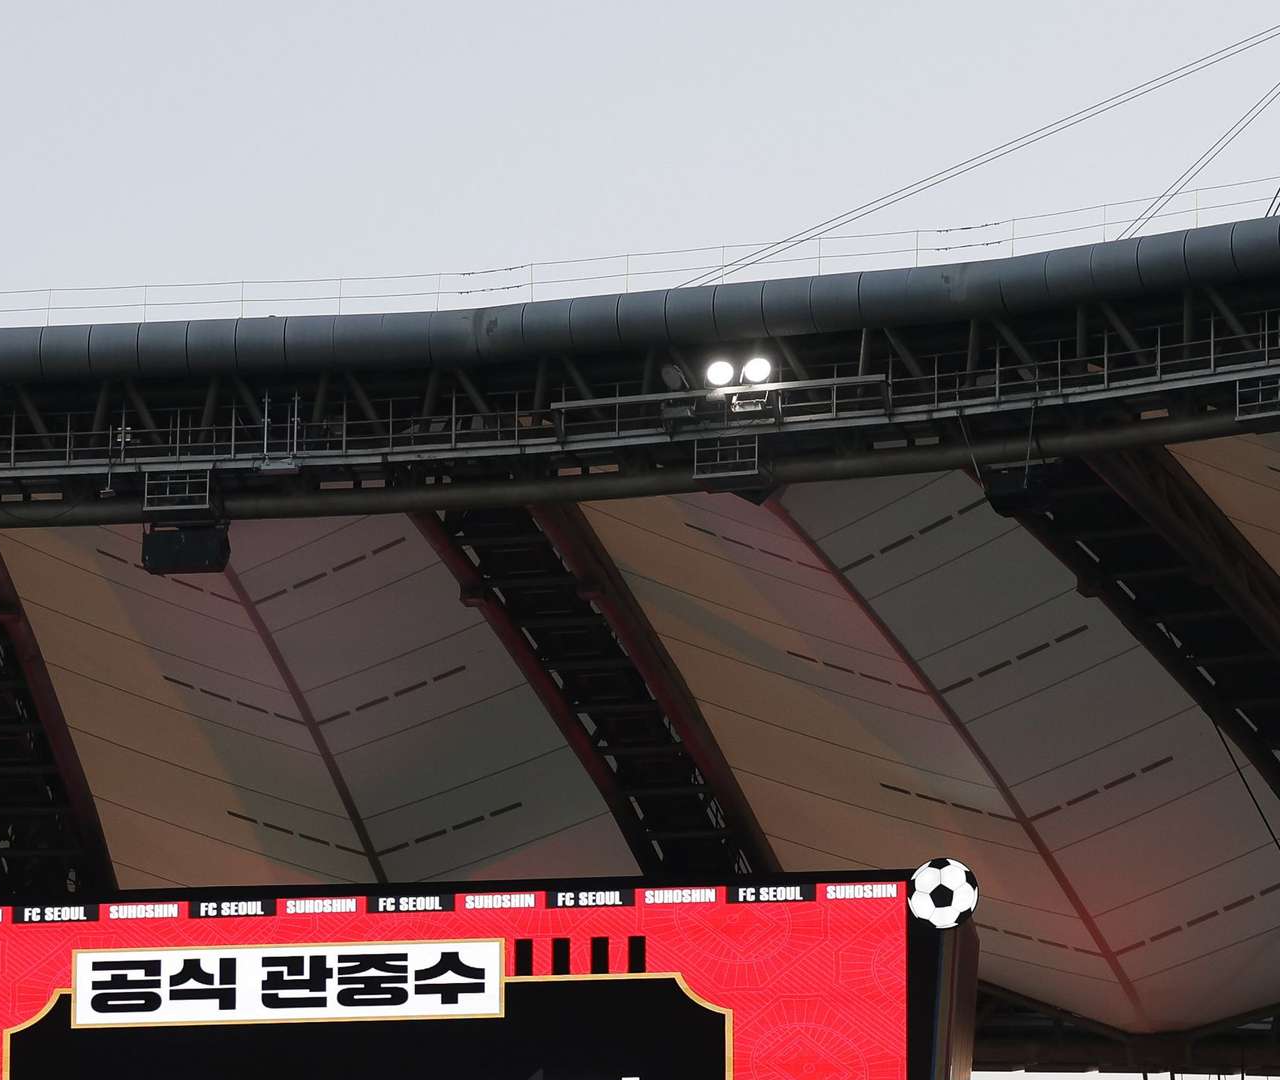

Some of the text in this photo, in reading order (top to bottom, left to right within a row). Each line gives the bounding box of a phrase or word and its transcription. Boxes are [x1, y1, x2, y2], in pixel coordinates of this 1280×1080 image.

[24, 907, 41, 922] FC
[45, 906, 87, 921] SEOUL
[109, 903, 179, 919] SUHOSHIN
[200, 902, 218, 917] FC
[221, 900, 265, 916] SEOUL
[286, 898, 357, 914] SUHOSHIN
[378, 897, 396, 911] FC
[399, 896, 443, 911] SEOUL
[464, 893, 535, 909] SUHOSHIN
[557, 892, 575, 907] FC
[578, 890, 623, 906] SEOUL
[644, 888, 716, 904] SUHOSHIN
[738, 887, 756, 901] FC
[760, 886, 804, 901] SEOUL
[826, 883, 897, 899] SUHOSHIN
[90, 951, 486, 1014] 공식 관중수
